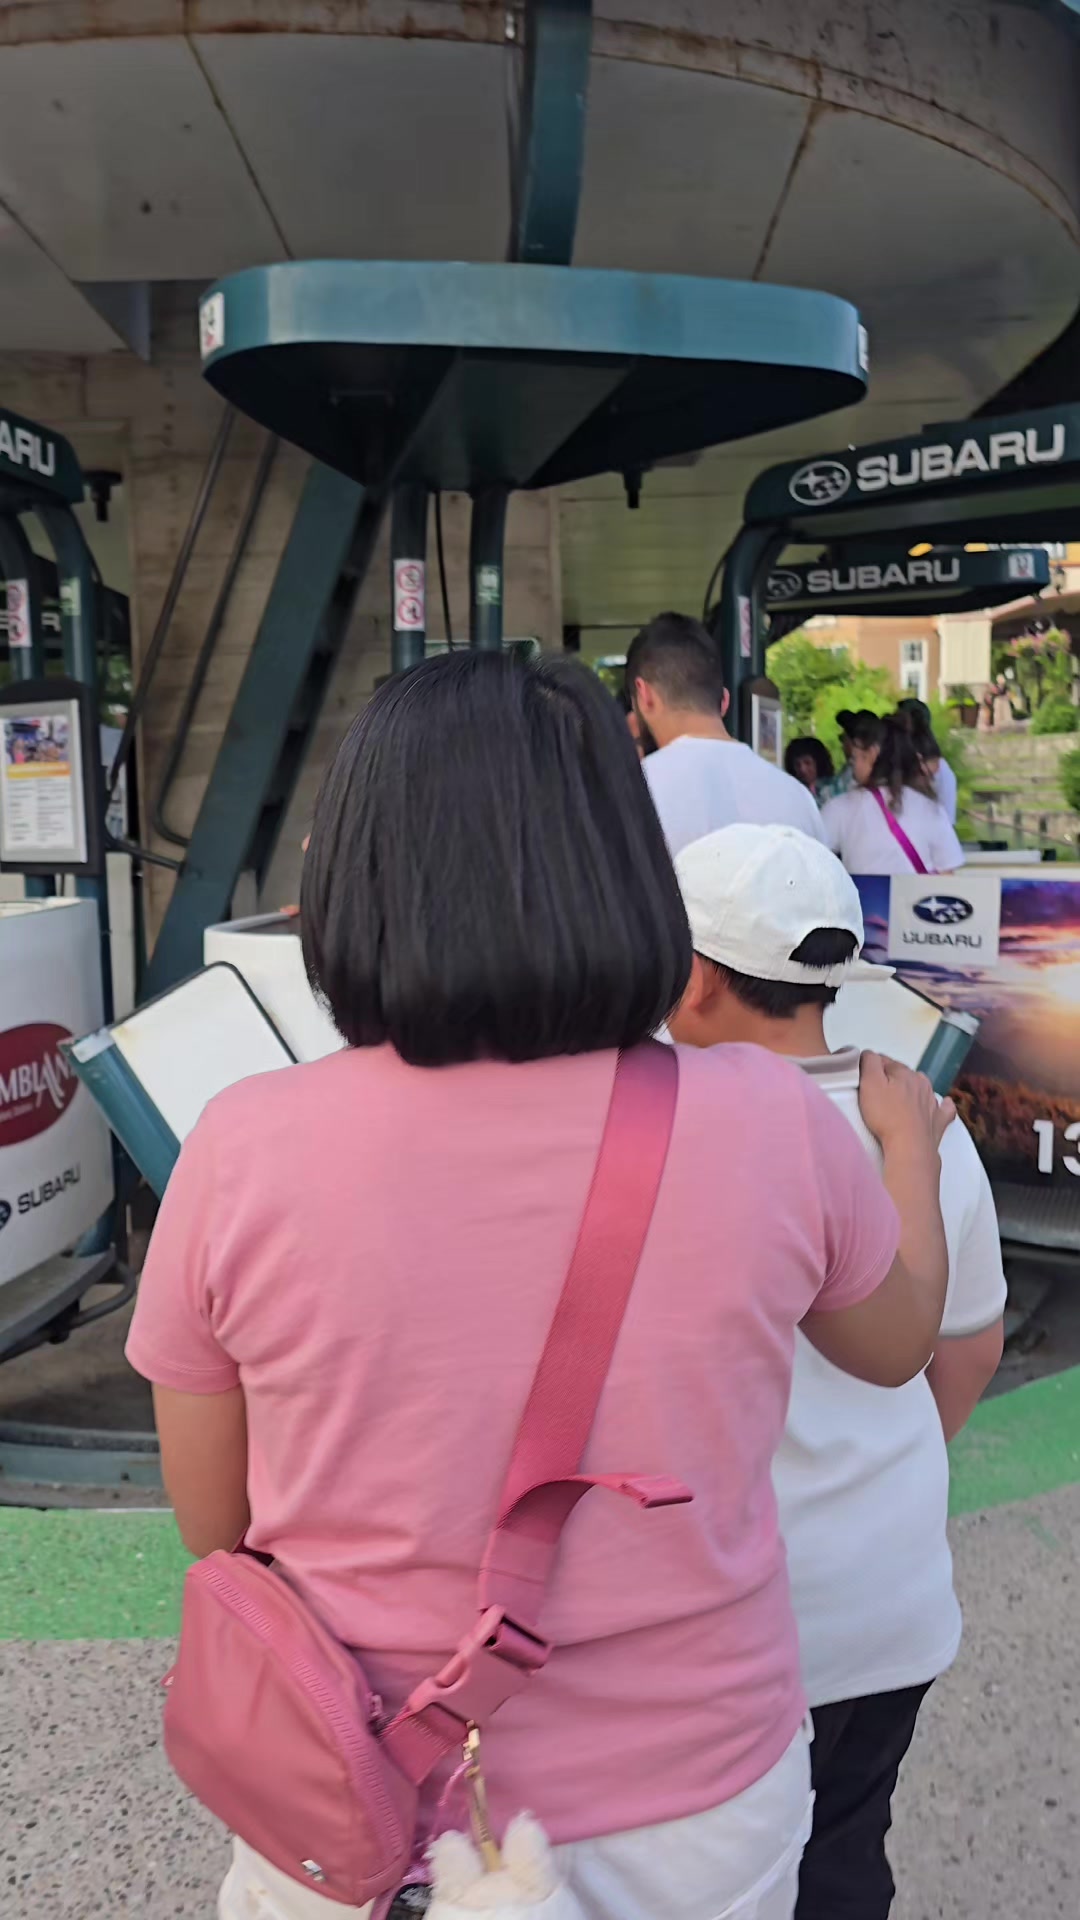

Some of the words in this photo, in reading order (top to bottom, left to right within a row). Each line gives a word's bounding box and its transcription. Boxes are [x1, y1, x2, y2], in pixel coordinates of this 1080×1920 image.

[856, 424, 1065, 492] SUBARU
[807, 558, 960, 592] SUBARU
[17, 1163, 81, 1214] SUBARU
